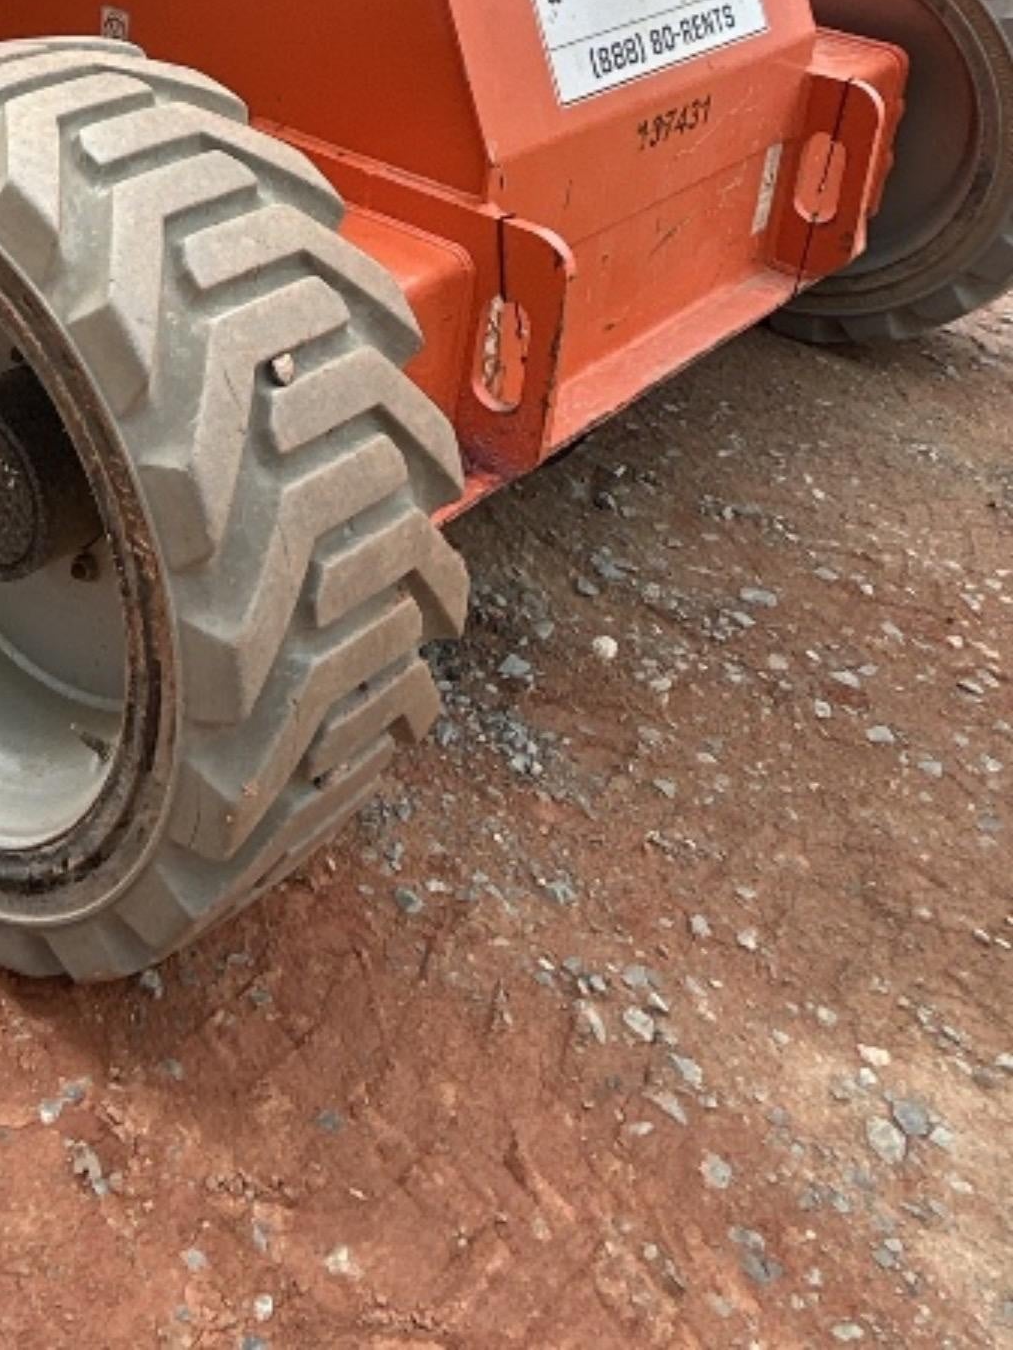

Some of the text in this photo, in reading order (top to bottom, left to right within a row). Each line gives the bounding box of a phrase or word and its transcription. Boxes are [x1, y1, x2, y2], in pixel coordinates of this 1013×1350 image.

[589, 4, 736, 79] (888) 80-RENTS
[637, 94, 712, 150] 137431
